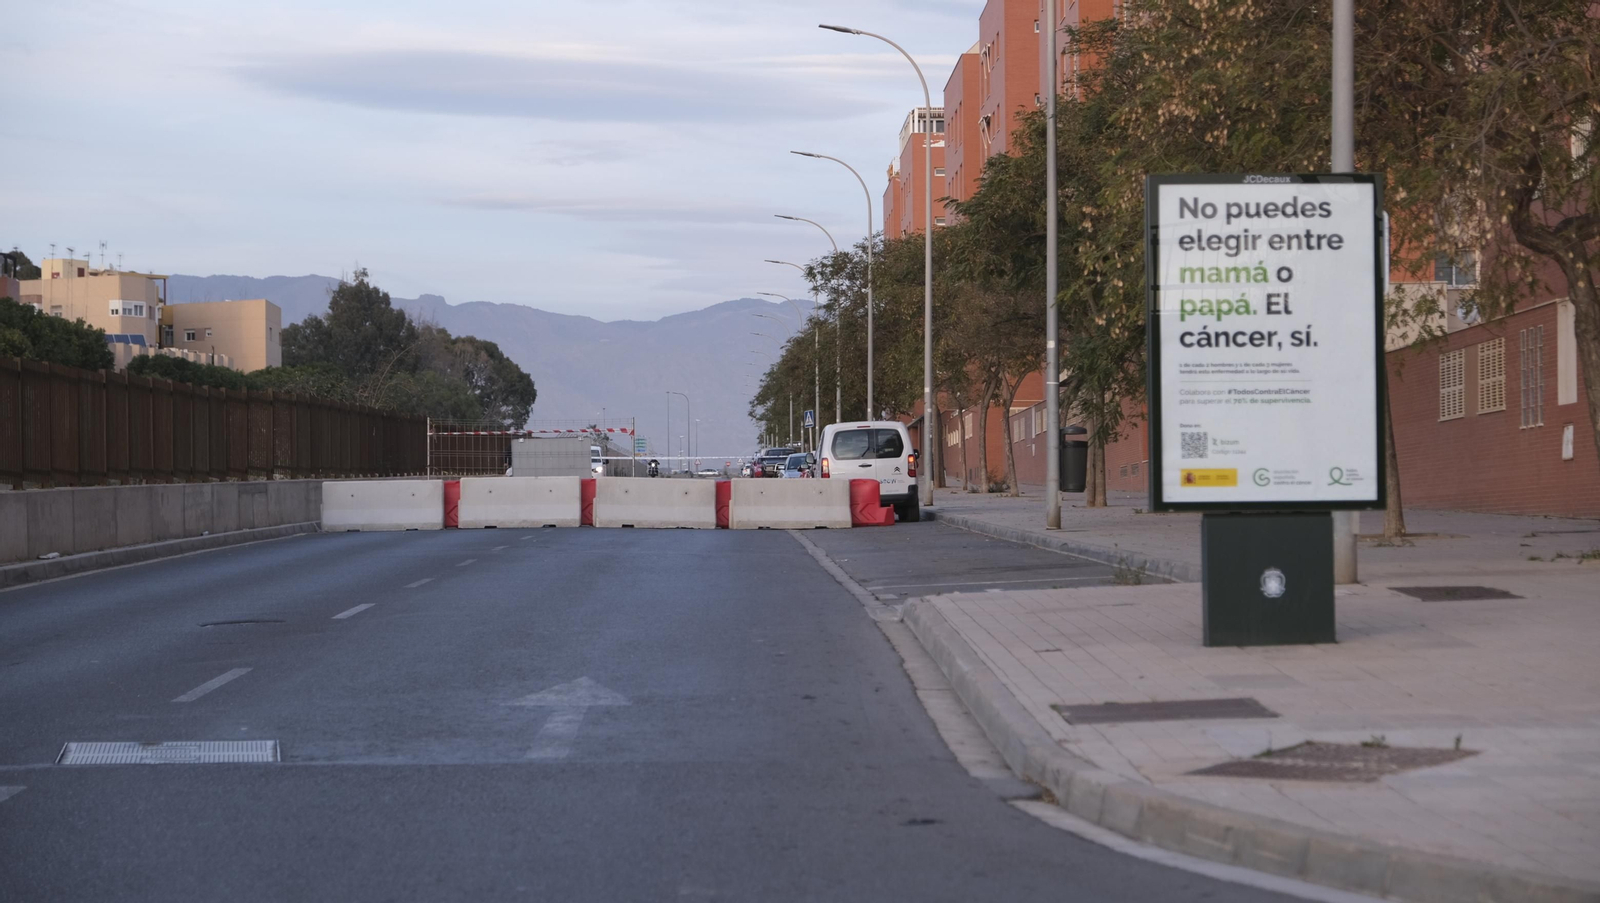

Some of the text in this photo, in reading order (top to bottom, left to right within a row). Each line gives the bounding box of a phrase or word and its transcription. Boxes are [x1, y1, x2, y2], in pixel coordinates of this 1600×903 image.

[1243, 175, 1291, 184] JCDecaux
[1178, 196, 1332, 225] No puedes
[1178, 229, 1344, 257] elegir entre
[1179, 260, 1293, 283] mamá o
[1179, 293, 1292, 322] papá. El
[1179, 325, 1318, 351] cáncer, sí.
[1179, 388, 1212, 396] Colabora
[1227, 388, 1311, 396] #TodosContraElCáncer
[1260, 397, 1312, 405] supervivencia.
[1220, 438, 1240, 446] bizum
